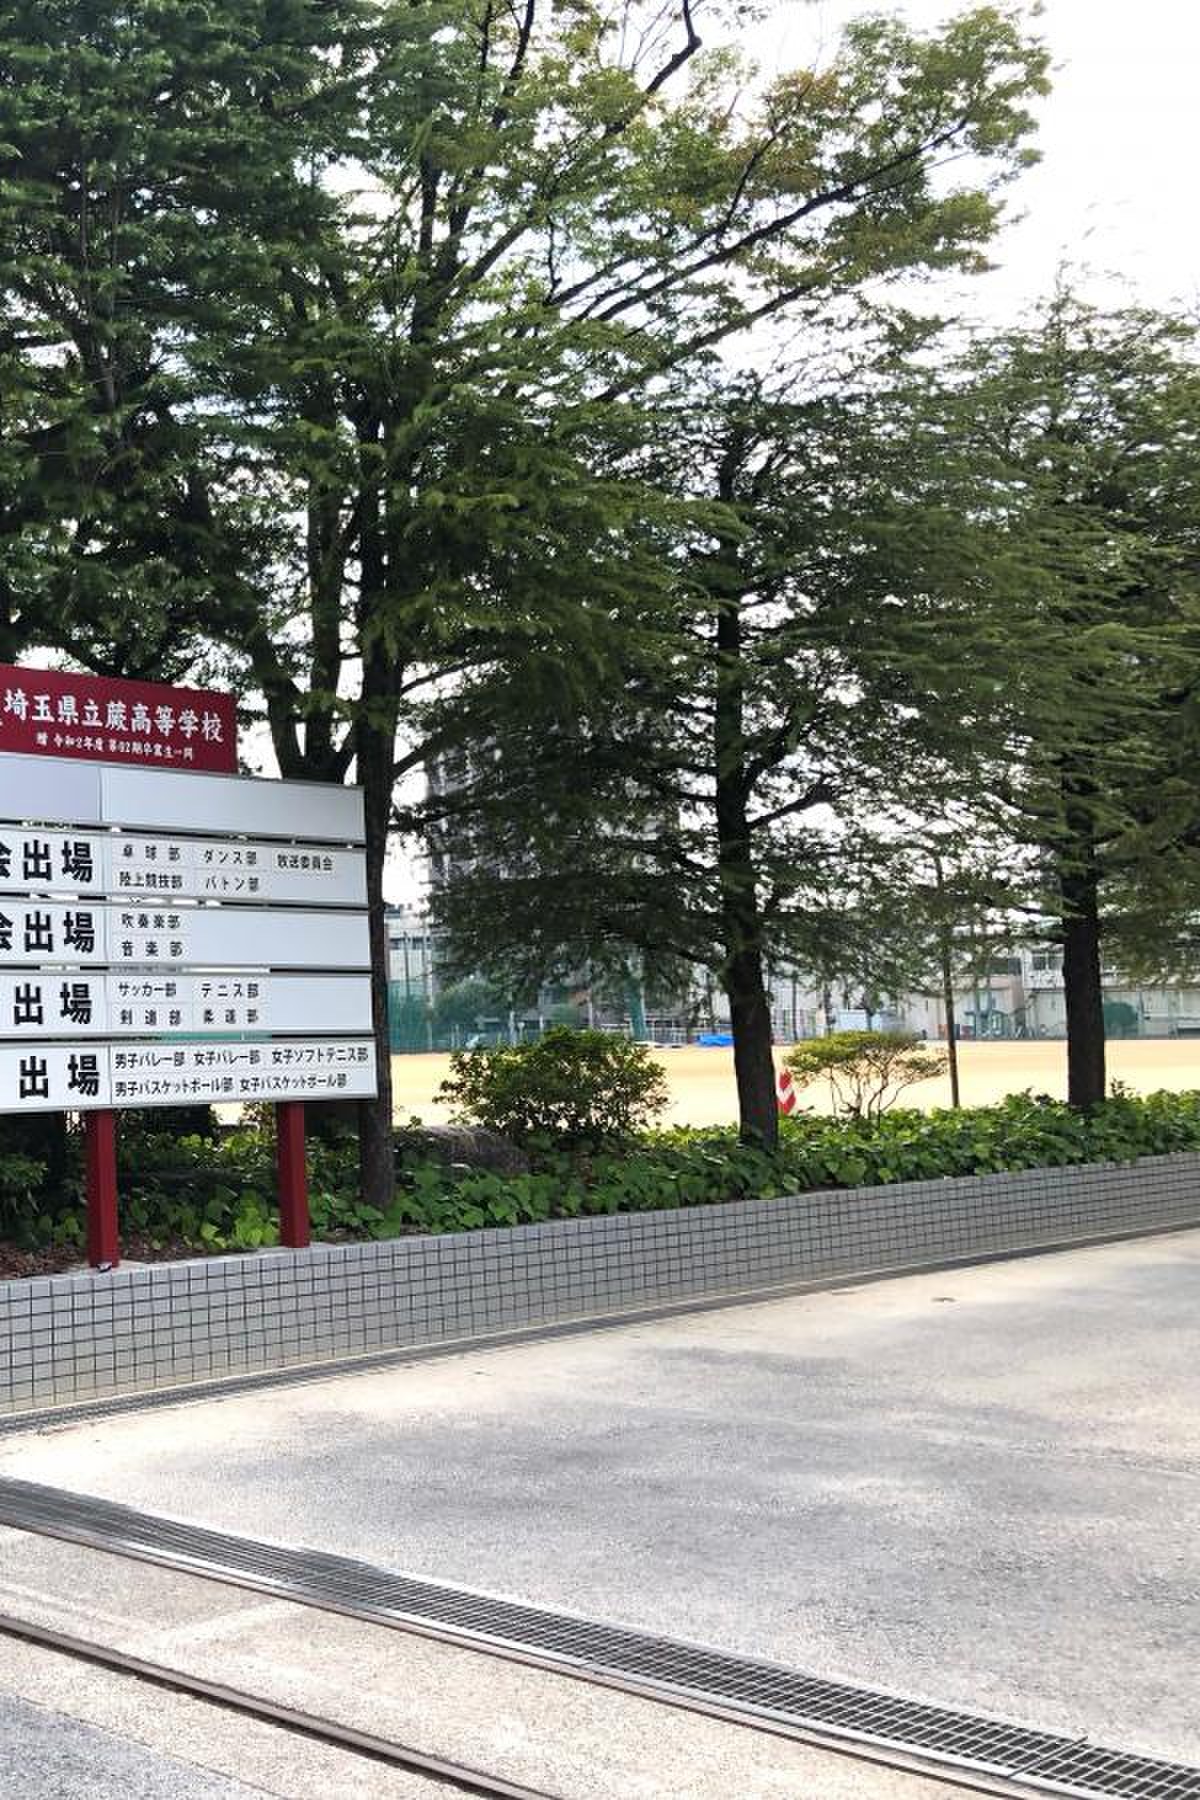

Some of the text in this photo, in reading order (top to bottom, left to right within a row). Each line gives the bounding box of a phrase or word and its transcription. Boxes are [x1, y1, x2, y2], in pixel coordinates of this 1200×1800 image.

[3, 688, 225, 743] 埼玉県立蕨高等学校
[122, 844, 333, 871] 卓球部 ダンス部 放送委員会
[119, 871, 259, 892] 陸上競技部 バトン部
[121, 913, 180, 929] 吹奏楽部
[121, 941, 183, 957] 音楽部
[118, 983, 259, 998] サッカー部 テニス部
[203, 1009, 259, 1024] 柔道部
[115, 1047, 368, 1069] 男子バレー部 女子バレー部 女子ソフトテニス部
[115, 1073, 347, 1097] 男子バスケットボール部 女子バスケットボール部
